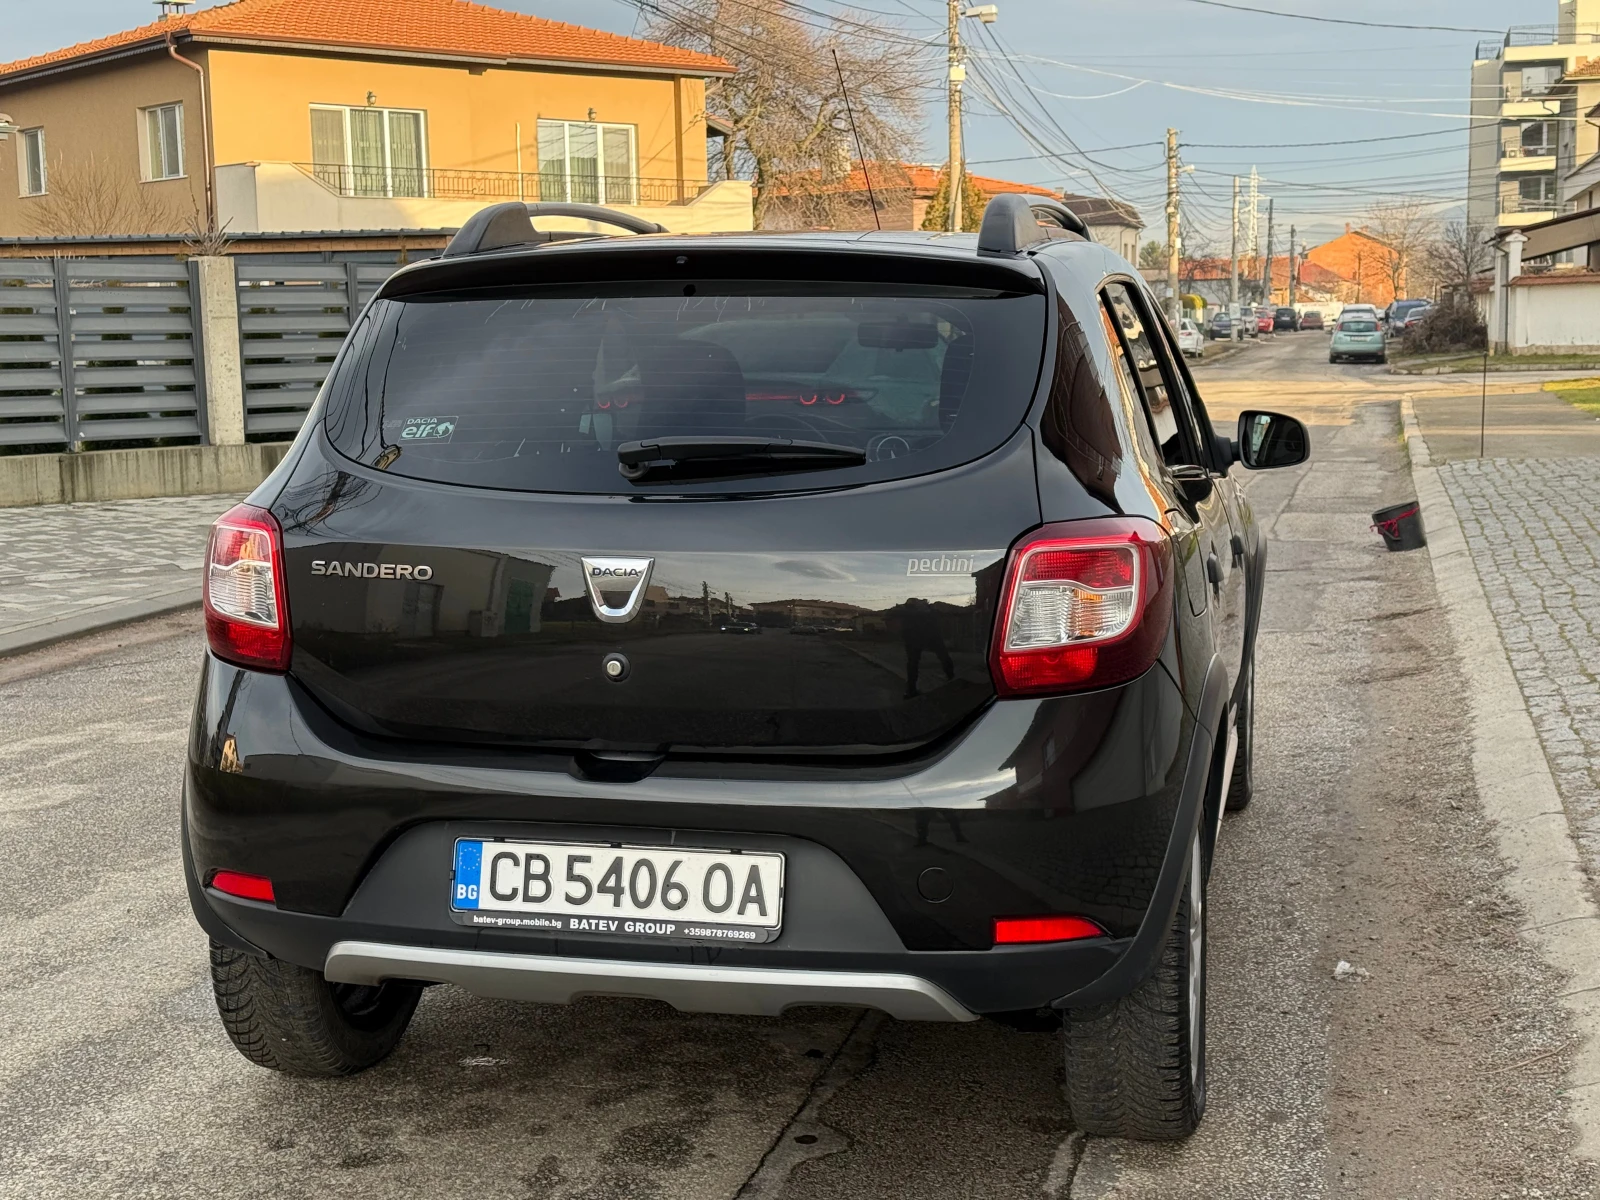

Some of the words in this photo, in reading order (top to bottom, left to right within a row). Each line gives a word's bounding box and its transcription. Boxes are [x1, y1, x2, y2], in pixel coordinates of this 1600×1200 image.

[402, 424, 436, 438] elf
[311, 560, 434, 581] SANDERO
[592, 568, 640, 577] DACIA
[906, 554, 974, 576] pechini
[457, 883, 478, 900] BG
[489, 851, 553, 904] CB
[565, 854, 690, 911] 5406
[702, 863, 768, 917] OA
[473, 915, 562, 929] batev-group.mobile.bg
[569, 918, 619, 932] BATEV
[624, 921, 676, 935] GROUP
[684, 927, 756, 940] +359878769269
